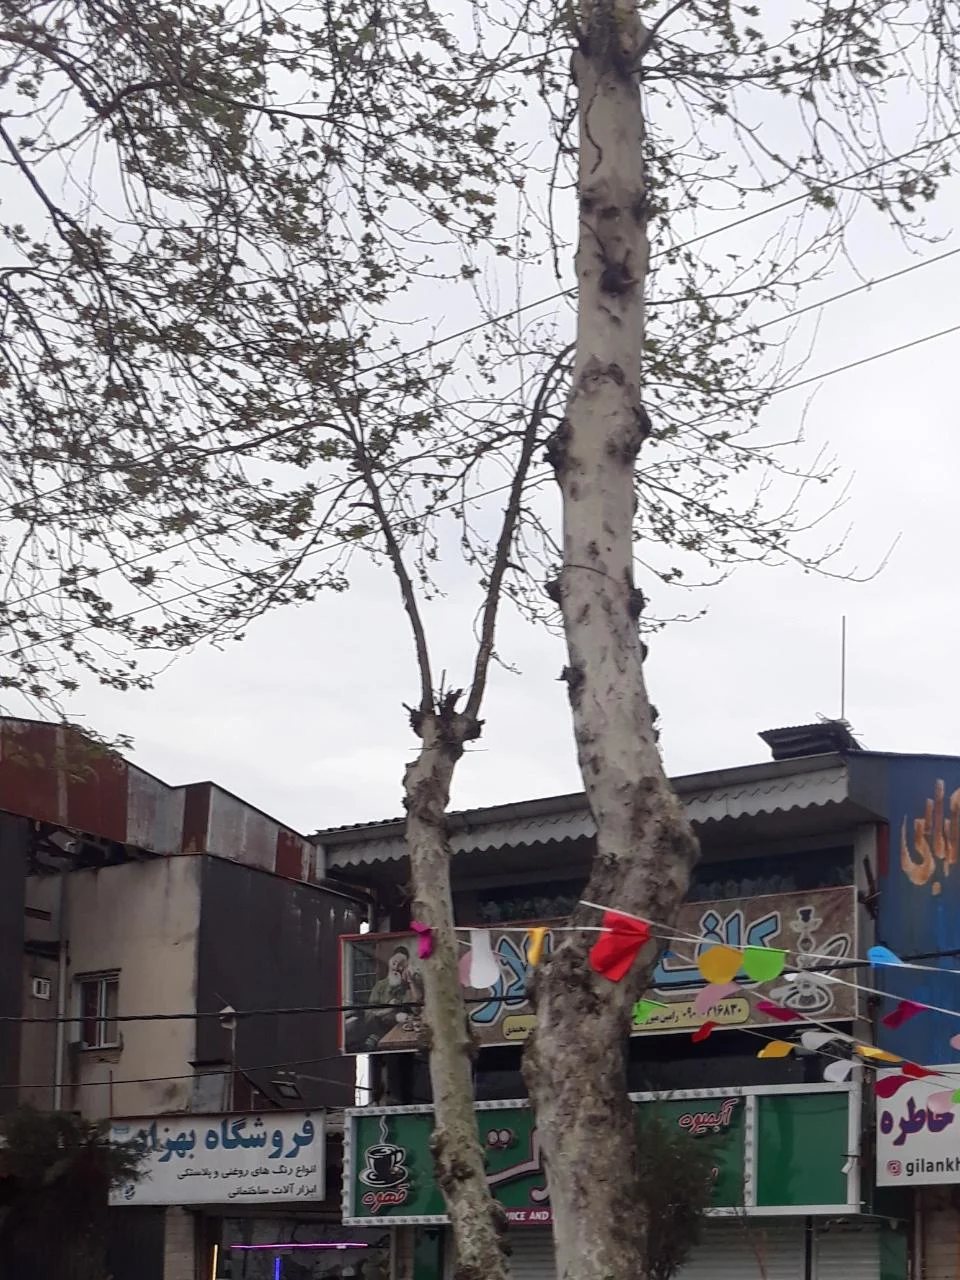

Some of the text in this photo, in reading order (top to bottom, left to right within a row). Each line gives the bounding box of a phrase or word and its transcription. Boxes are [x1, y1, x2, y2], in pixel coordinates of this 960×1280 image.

[205, 1112, 314, 1160] فروشگاه
[221, 1168, 249, 1179] روغنی
[251, 1166, 270, 1177] های
[272, 1165, 293, 1176] رنگ
[295, 1165, 316, 1178] انواع
[228, 1182, 316, 1198] ابزار آلات ساختمانی
[361, 1183, 409, 1214] قهوه
[528, 1211, 549, 1221] AND
